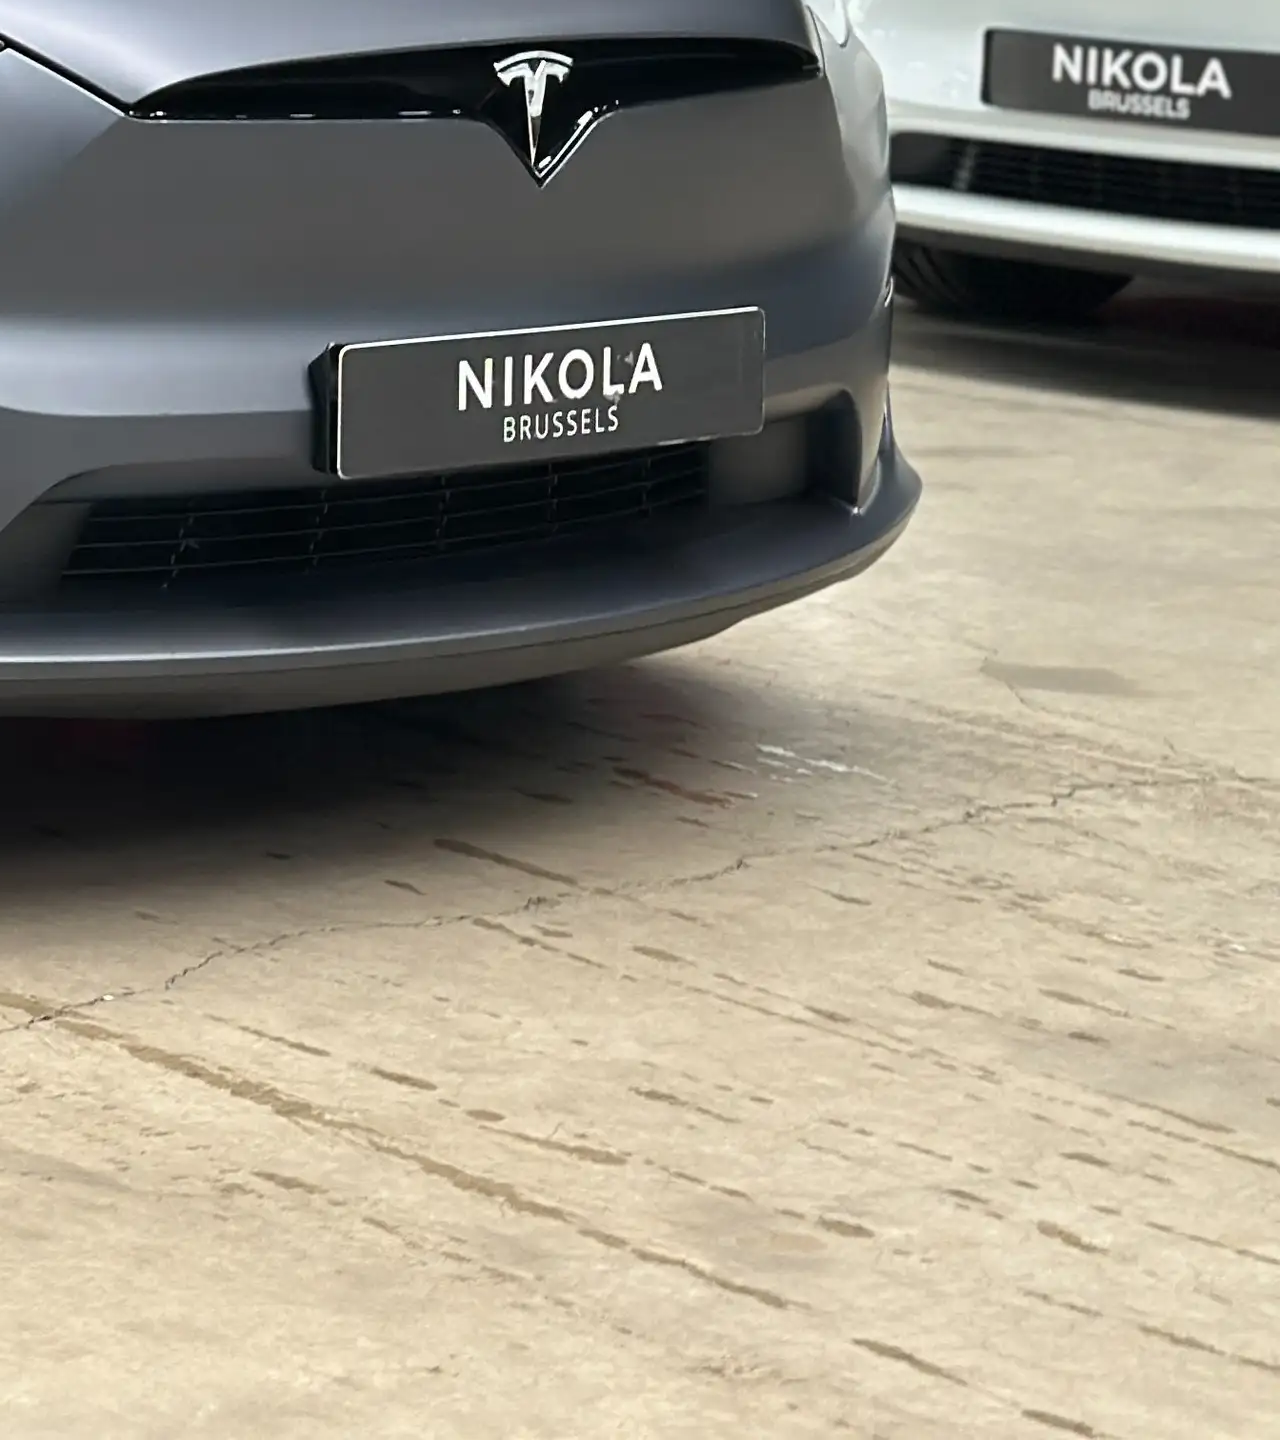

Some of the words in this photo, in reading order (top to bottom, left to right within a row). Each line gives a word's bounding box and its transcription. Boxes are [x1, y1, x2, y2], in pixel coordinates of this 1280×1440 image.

[1052, 42, 1232, 100] NIKOLA
[1087, 87, 1192, 120] BRUSSELS
[458, 342, 663, 411] NIKOLA
[503, 405, 620, 443] BRUSSELS
